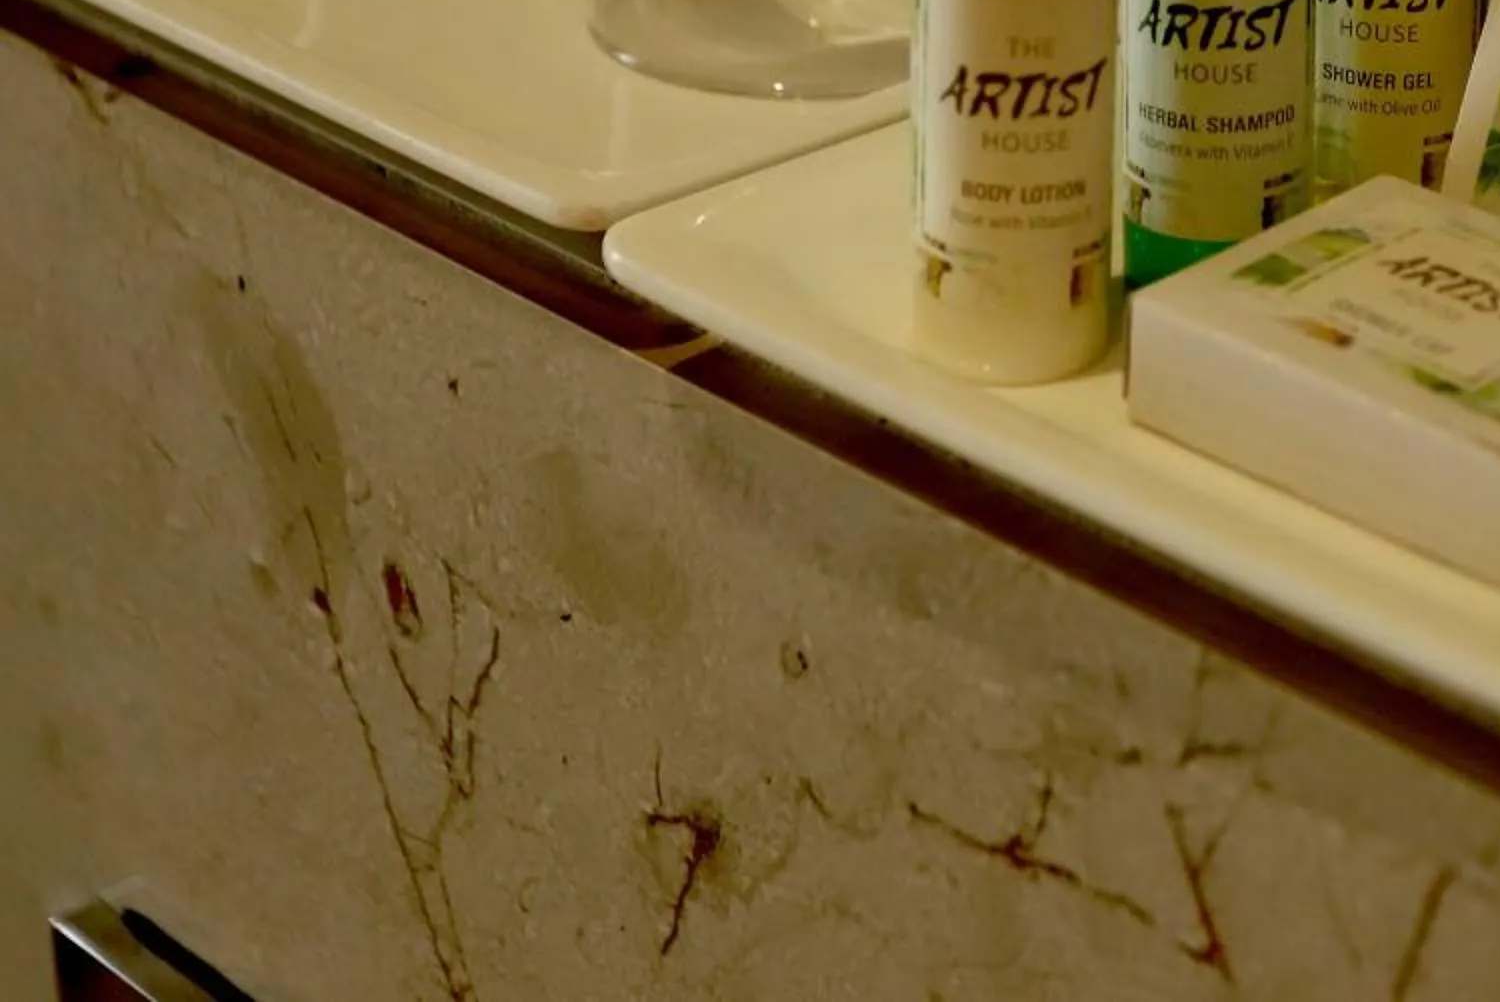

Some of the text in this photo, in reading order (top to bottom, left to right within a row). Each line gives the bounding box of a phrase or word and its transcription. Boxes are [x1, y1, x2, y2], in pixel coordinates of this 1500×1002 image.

[1340, 17, 1419, 44] HOUSE
[1008, 36, 1056, 60] THE
[1173, 62, 1258, 85] HOUSE
[1322, 62, 1435, 92] SHOWER GEL
[940, 56, 1108, 119] ARTIST
[1139, 101, 1295, 134] HERBAL SHAMPOO
[1348, 98, 1379, 116] with
[982, 129, 1070, 153] HOUSE
[961, 178, 1087, 205] BODY LOTION
